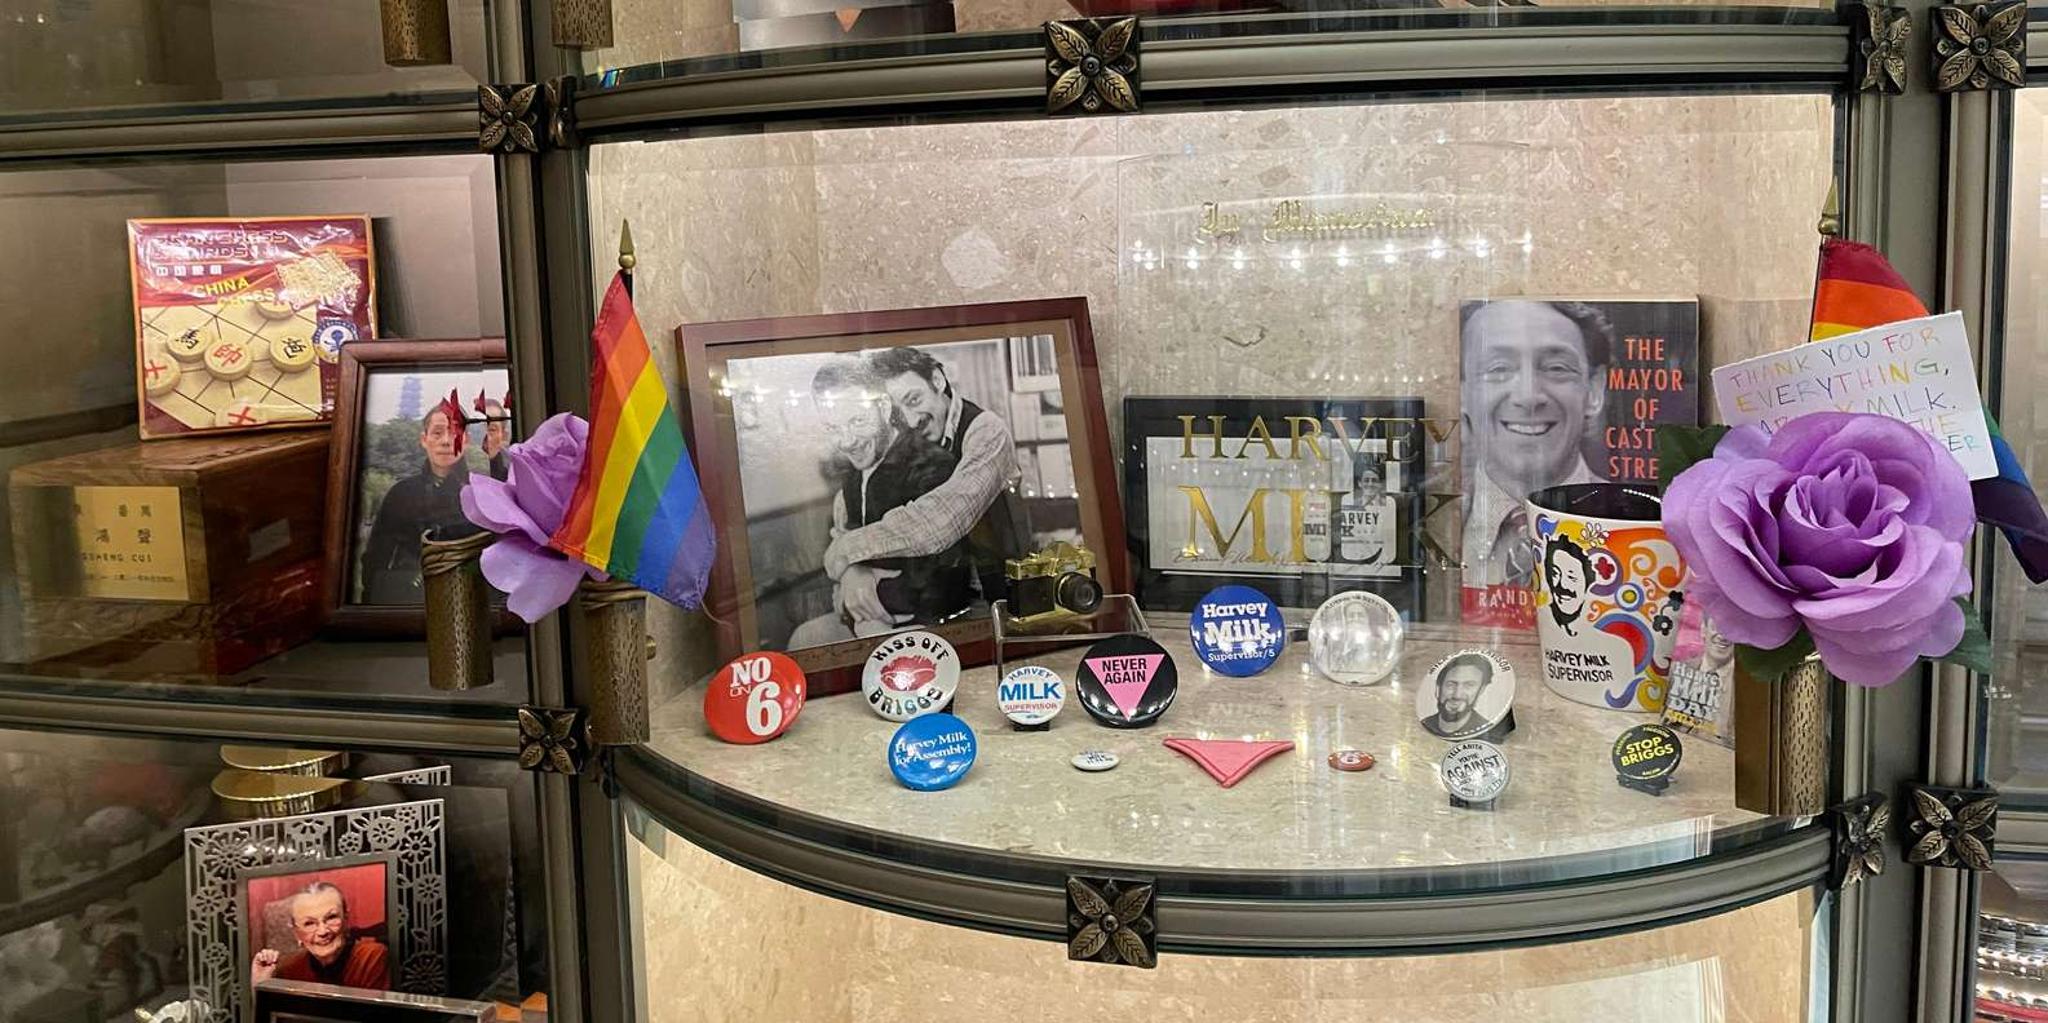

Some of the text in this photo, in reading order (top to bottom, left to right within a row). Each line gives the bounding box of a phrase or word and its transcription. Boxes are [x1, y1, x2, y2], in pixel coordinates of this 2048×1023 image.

[193, 276, 250, 298] CHINA
[1625, 338, 1665, 361] THE
[1729, 326, 1941, 388] THANK YOU FOR
[1609, 368, 1684, 391] MAYOR
[1735, 358, 1950, 413] EVERYTHING,
[1634, 399, 1660, 420] OF
[1866, 386, 1957, 418] MILK.
[1176, 414, 1460, 463] HARVEY
[1606, 427, 1657, 450] CAST
[1609, 456, 1660, 480] STRE
[1177, 484, 1469, 569] MILK
[1201, 602, 1268, 619] Harvey
[1203, 618, 1273, 644] Milk
[871, 635, 917, 662] KISS
[921, 636, 950, 661] OFF
[1207, 648, 1276, 663] Supervisor/5
[1544, 649, 1611, 667] HARVEY MILK
[730, 656, 773, 688] NO
[1008, 667, 1054, 682] HARVEY
[1102, 657, 1148, 673] NEVER
[1547, 662, 1614, 683] SUPERVISOR
[1103, 670, 1147, 685] AGAIN
[729, 684, 753, 698] ON
[869, 687, 944, 716] BRIGGS
[1000, 681, 1062, 702] MILK
[745, 681, 784, 737] 6
[1003, 702, 1059, 713] SUPERVISOR
[894, 731, 968, 754] Harvey Milk
[913, 742, 972, 762] Assembly!
[1625, 736, 1662, 755] STOP
[1620, 742, 1675, 767] BRIGGS
[1446, 753, 1501, 781] AGAINST
